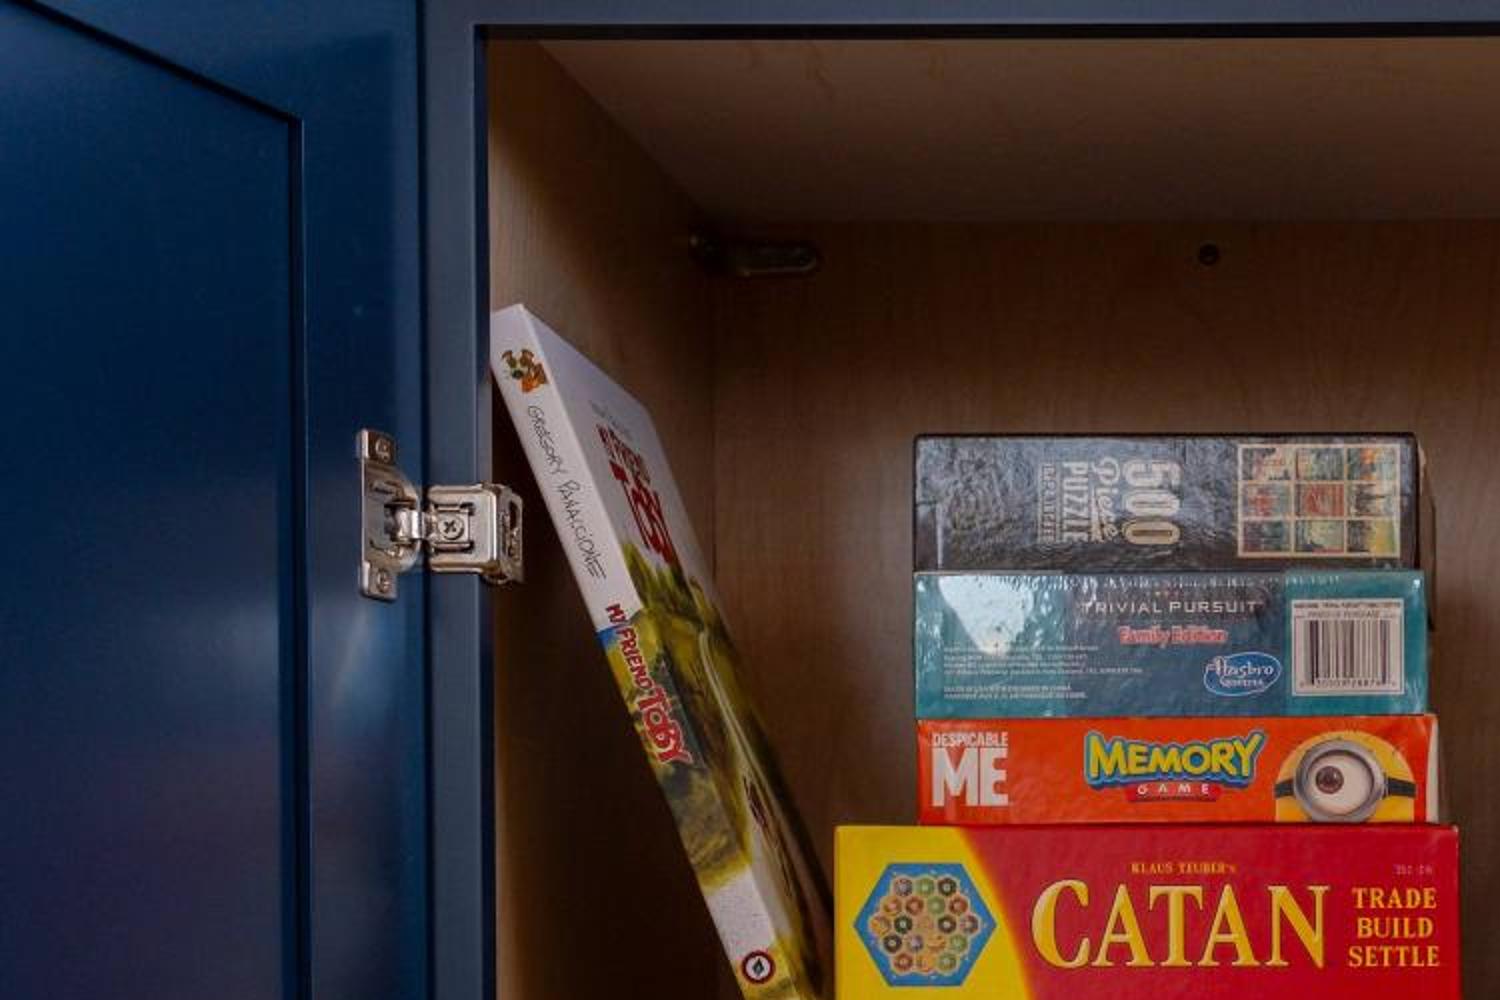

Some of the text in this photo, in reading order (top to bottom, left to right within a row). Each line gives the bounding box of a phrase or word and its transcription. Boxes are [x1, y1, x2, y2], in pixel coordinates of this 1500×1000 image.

[527, 405, 566, 475] GREGORY
[1062, 461, 1088, 544] PUZZLE
[1121, 459, 1182, 546] 500
[1080, 600, 1258, 614] TRIVIAL PURSUIT
[1205, 655, 1275, 678] Hasbro
[616, 624, 653, 691] FRIEND
[636, 686, 695, 766] TOBY
[931, 731, 1009, 748] DESPICABLE
[1087, 730, 1265, 783] MEMORY
[932, 748, 1009, 808] ME
[1137, 783, 1211, 797] GAME
[1352, 886, 1438, 910] TRADE
[1031, 878, 1331, 970] CATAN
[1356, 916, 1434, 940] BUILD
[1348, 945, 1440, 969] SETTLE
